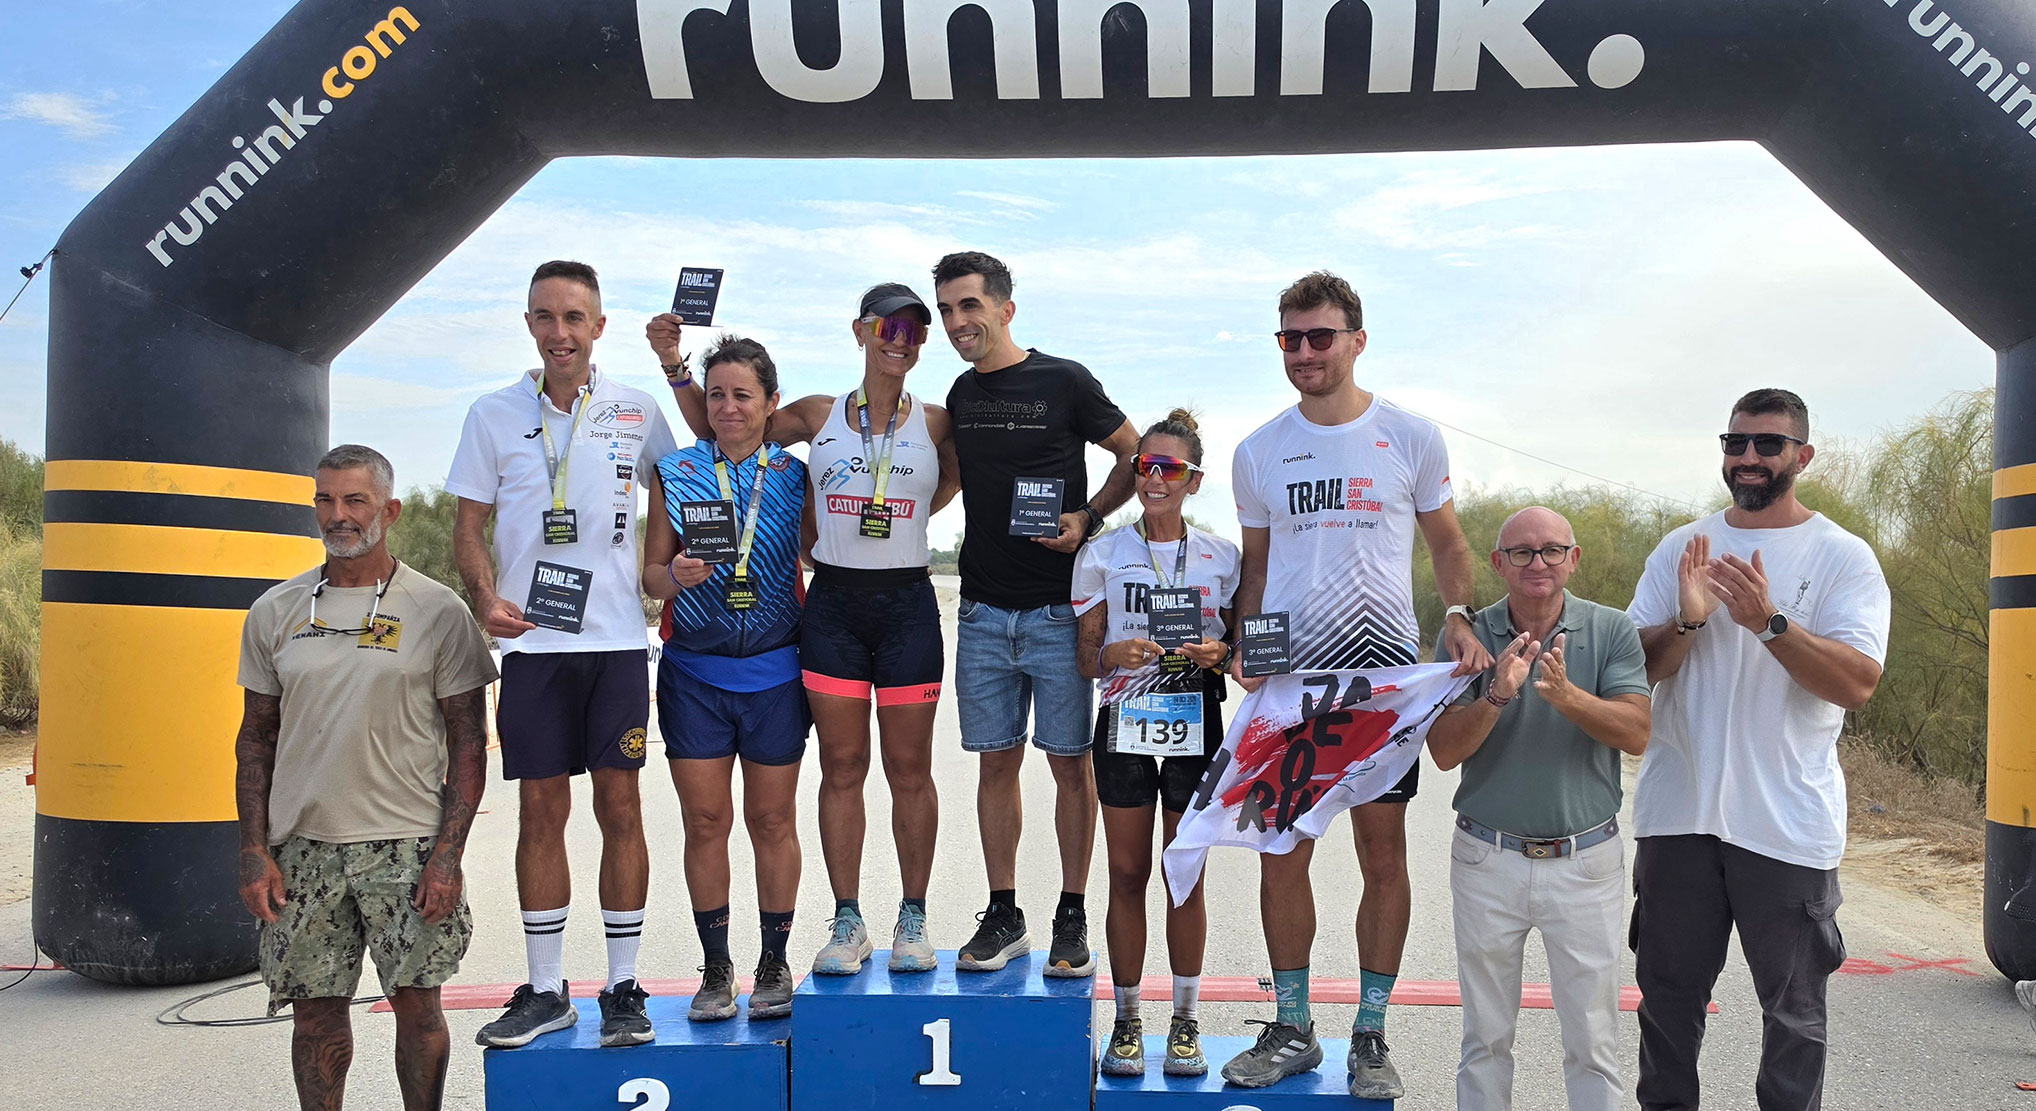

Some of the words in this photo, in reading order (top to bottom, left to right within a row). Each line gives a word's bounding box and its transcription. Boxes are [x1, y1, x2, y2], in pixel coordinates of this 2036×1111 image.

[145, 6, 421, 268] runnink.com
[590, 431, 613, 440] Jorge
[1282, 452, 1316, 464] runnink.
[1287, 478, 1345, 515] TRAIL
[1348, 477, 1373, 488] SIERRA
[1347, 488, 1362, 499] SAN
[1320, 519, 1345, 528] vuelve
[545, 599, 576, 611] GENERAL
[1150, 594, 1178, 609] TRAIL
[1245, 619, 1269, 635] TRAIL
[1256, 646, 1283, 655] GENERAL
[1135, 717, 1189, 745] 139
[919, 1018, 961, 1085] 1
